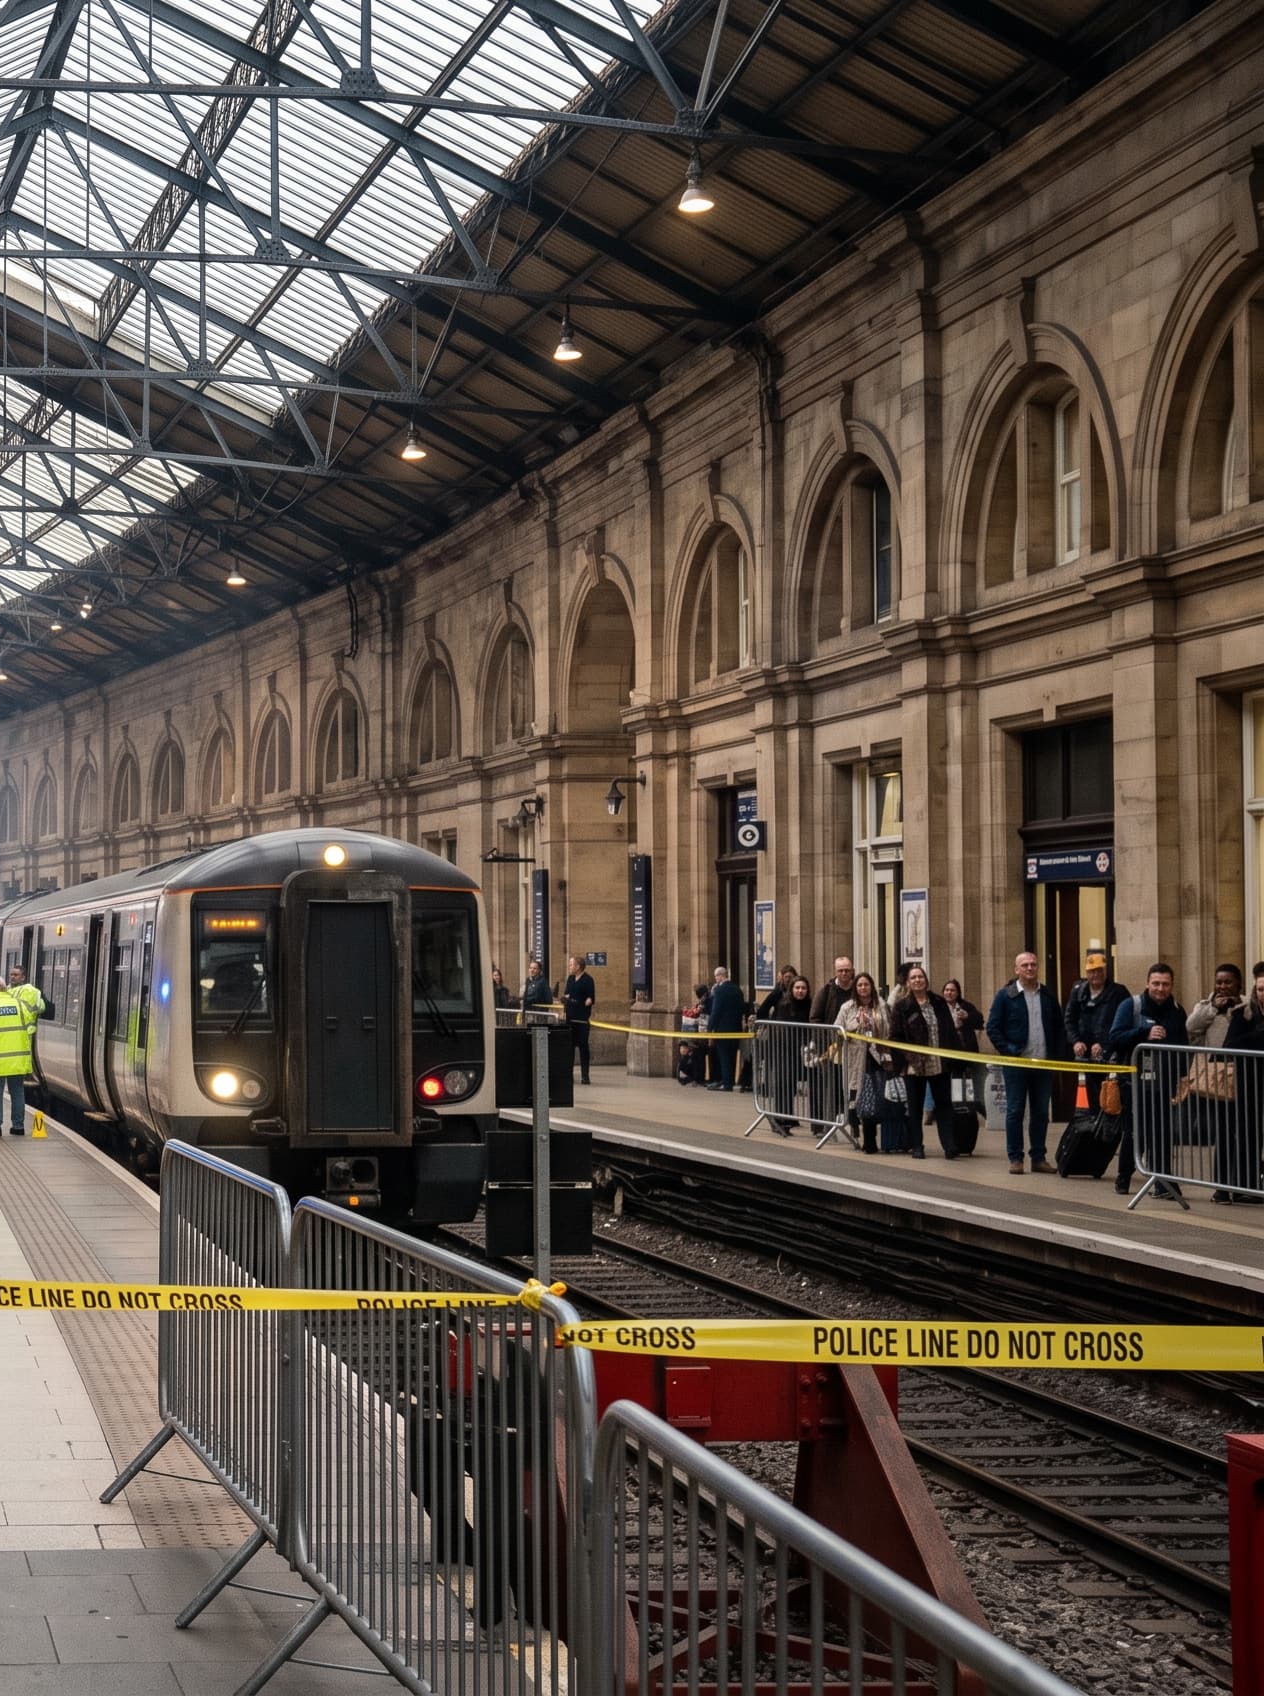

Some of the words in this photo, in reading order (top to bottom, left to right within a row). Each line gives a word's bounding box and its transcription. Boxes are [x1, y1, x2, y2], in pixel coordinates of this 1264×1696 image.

[29, 1288, 76, 1309] LINE
[82, 1290, 112, 1309] DO
[119, 1291, 161, 1310] NOT
[170, 1293, 243, 1310] CROSS
[616, 1326, 696, 1350] CROSS
[813, 1327, 898, 1357] POLICE
[907, 1328, 959, 1358] LINE
[967, 1329, 999, 1359] DO
[1008, 1330, 1056, 1360] NOT
[1064, 1331, 1144, 1362] CROSS
